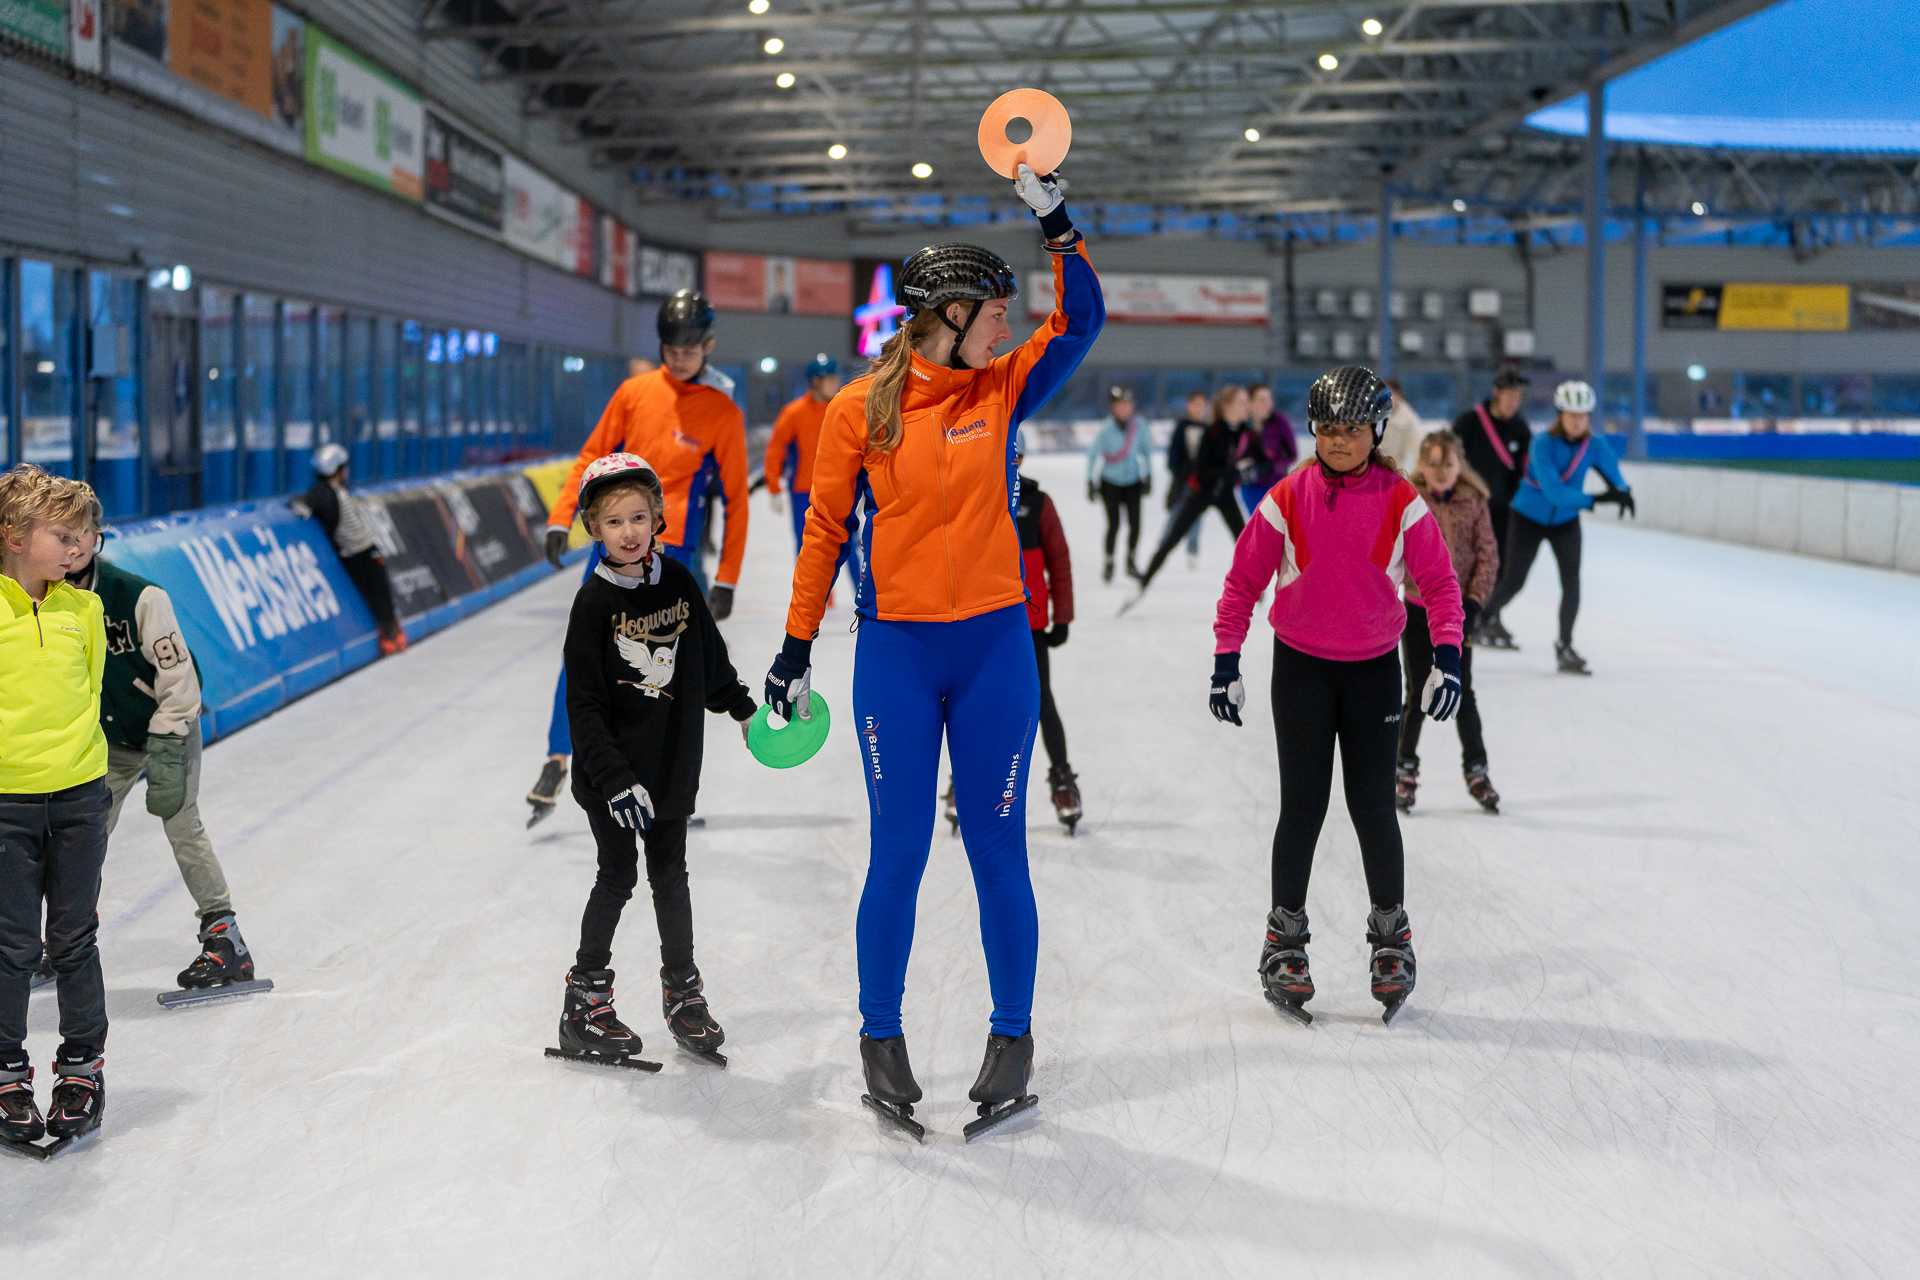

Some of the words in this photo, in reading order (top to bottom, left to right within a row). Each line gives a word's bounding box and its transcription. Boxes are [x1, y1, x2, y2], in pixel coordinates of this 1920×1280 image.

[180, 524, 340, 652] Websites
[612, 597, 690, 645] Hogwarts
[865, 716, 874, 729] In
[868, 735, 883, 780] Balans
[1003, 752, 1020, 799] Balans
[1000, 803, 1011, 817] In
